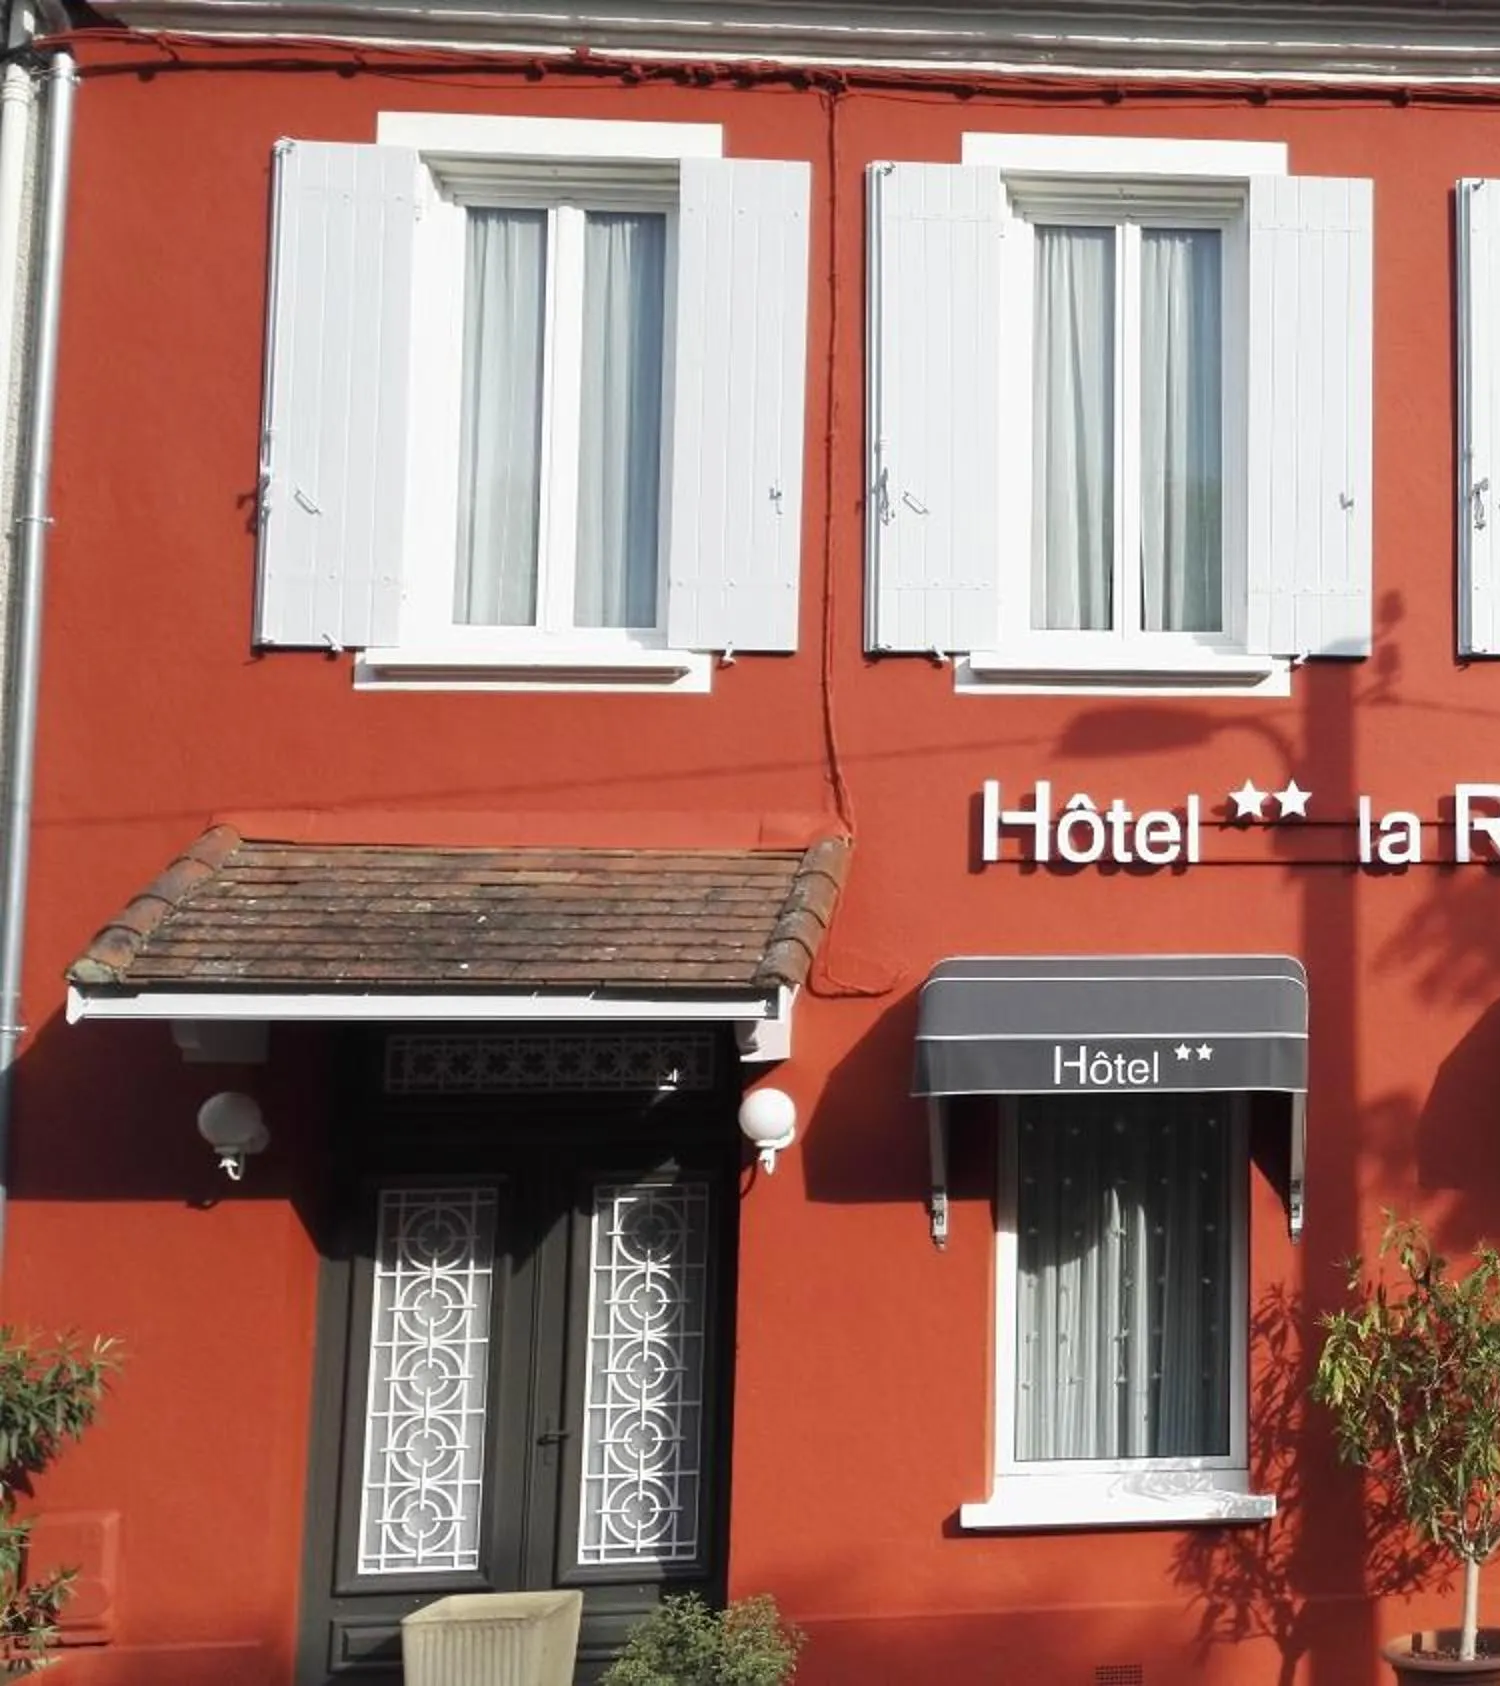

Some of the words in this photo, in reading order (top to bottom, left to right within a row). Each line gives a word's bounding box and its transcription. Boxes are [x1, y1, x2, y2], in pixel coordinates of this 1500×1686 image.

[982, 779, 1200, 864] Hôtel
[1358, 795, 1422, 864] la
[1052, 1045, 1160, 1086] Hôtel
